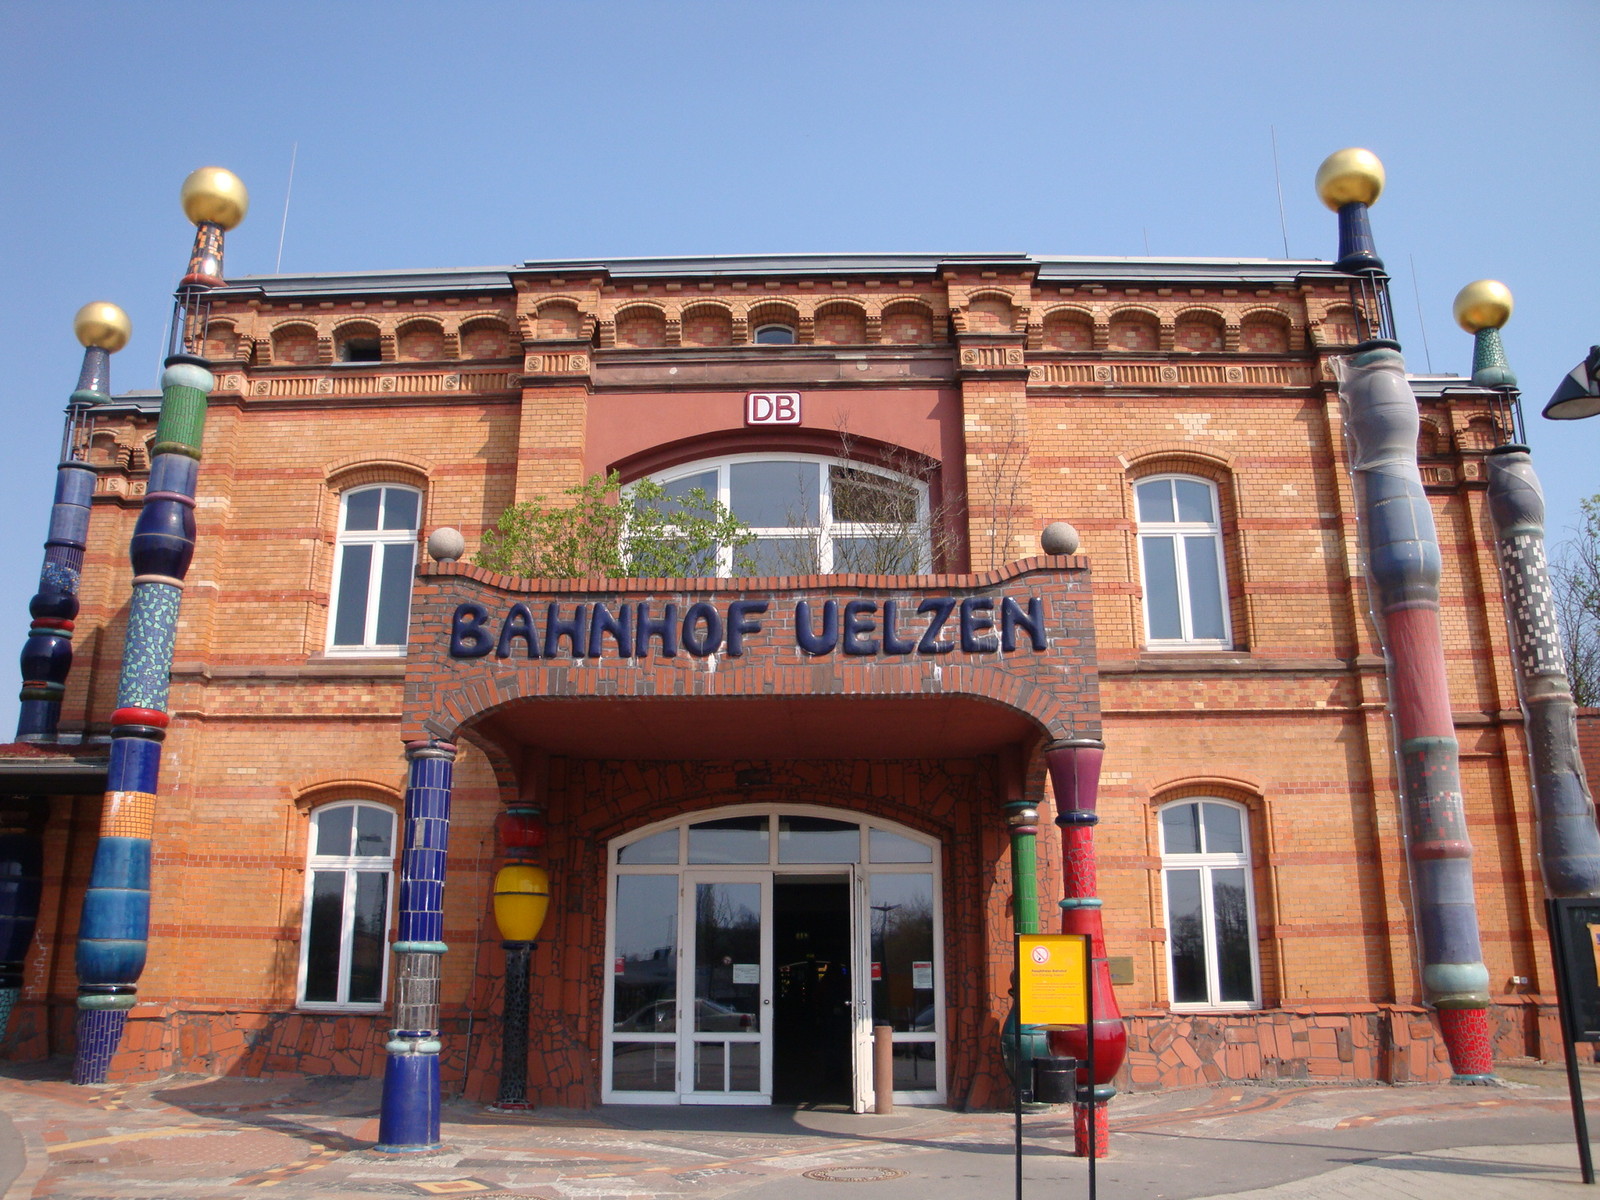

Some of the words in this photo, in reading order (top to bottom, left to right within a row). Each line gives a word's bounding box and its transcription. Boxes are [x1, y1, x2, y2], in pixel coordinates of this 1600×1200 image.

[752, 395, 797, 421] DB
[448, 600, 769, 659] BAHNHOF
[794, 596, 1048, 656] UELZEN
